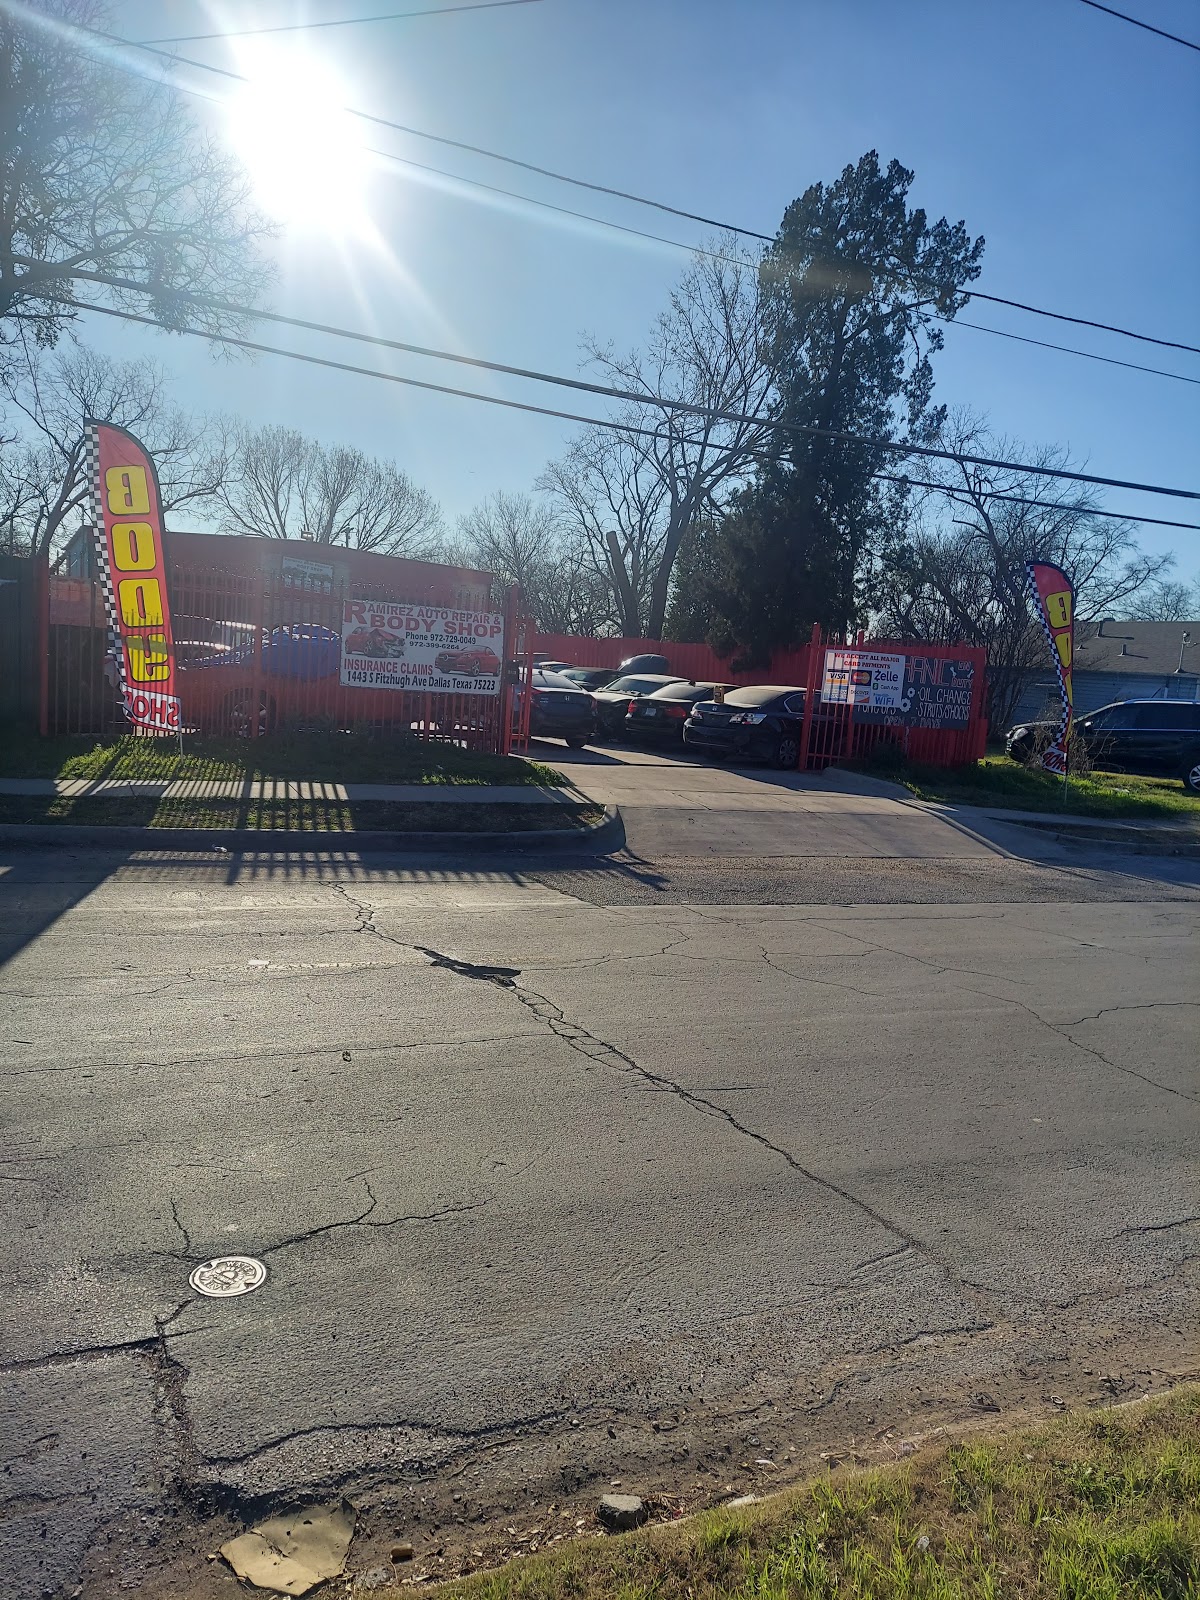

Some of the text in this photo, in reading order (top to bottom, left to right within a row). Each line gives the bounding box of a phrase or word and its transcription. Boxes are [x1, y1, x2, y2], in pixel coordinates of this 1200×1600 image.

[344, 602, 501, 626] RAMIREZ AUTO REPAIR &
[370, 614, 502, 638] BODY SHOP
[406, 632, 476, 644] Phone 972-729-0049
[344, 658, 433, 676] INSURANCE CLAIMS
[830, 672, 846, 680] VISA
[874, 669, 898, 682] Zelle
[347, 671, 496, 690] 1443 S Fitzhugh Ave Dallas Texas 75223
[919, 686, 972, 705] OIL CHANGE
